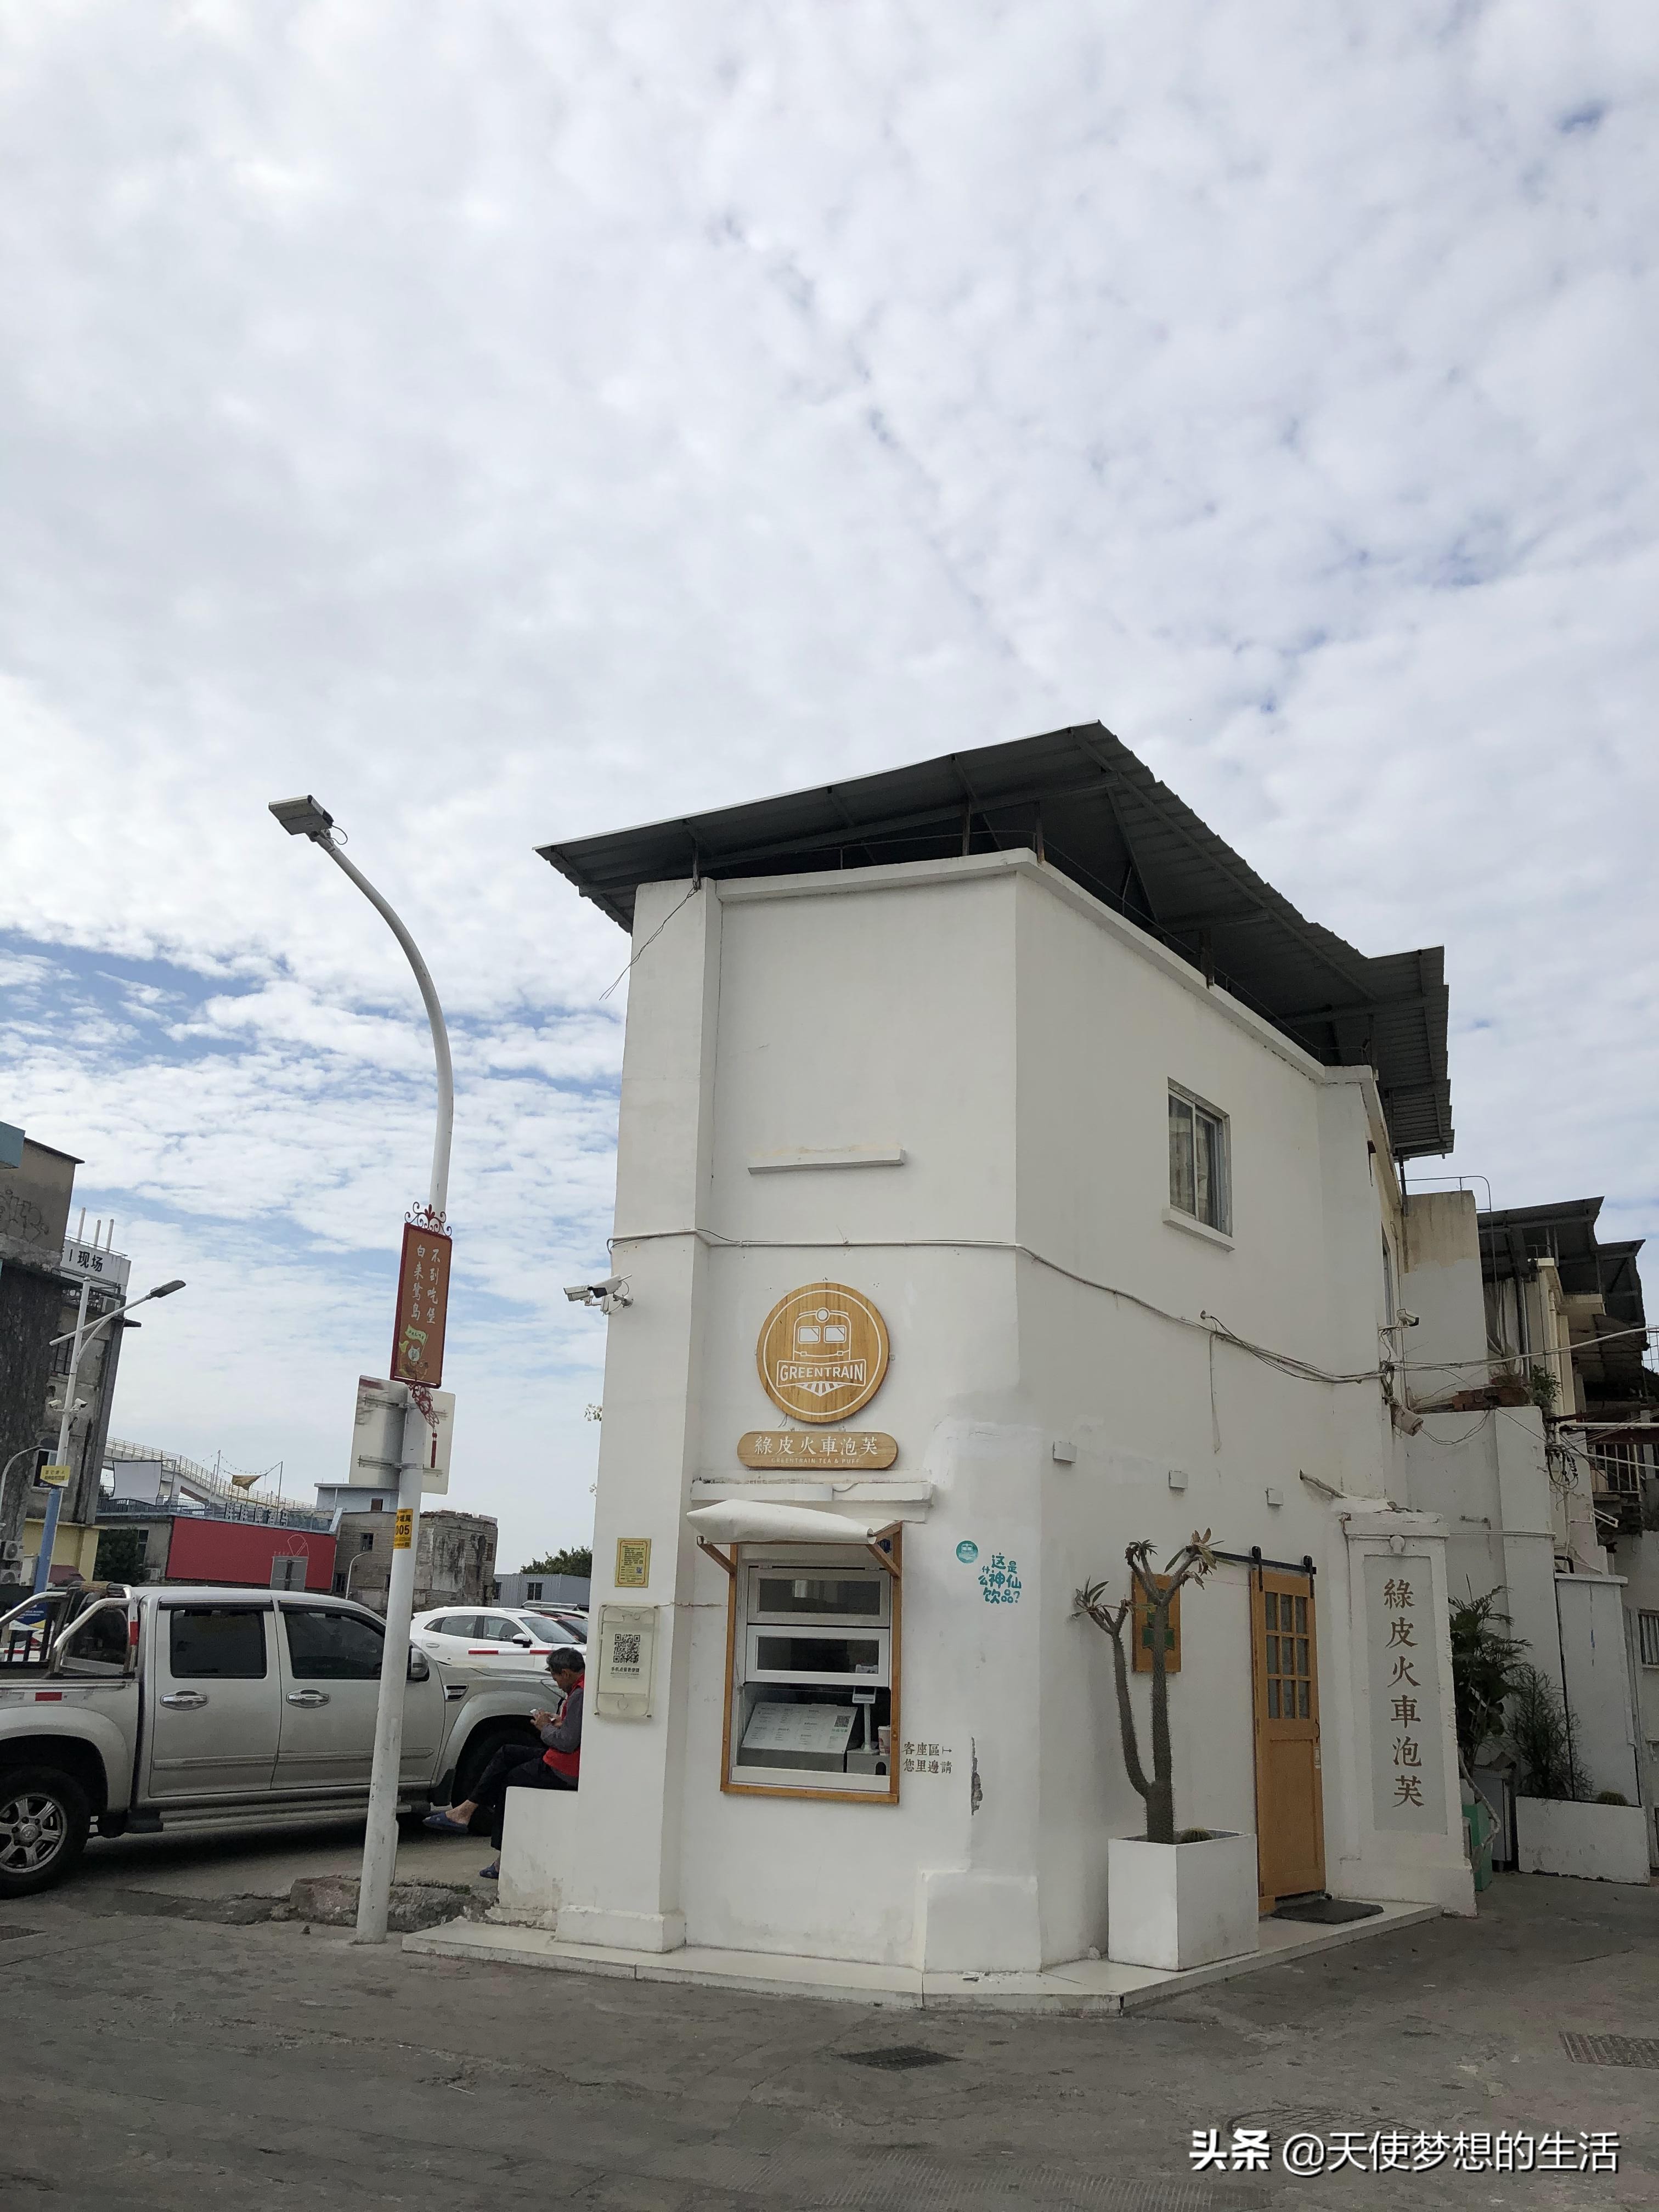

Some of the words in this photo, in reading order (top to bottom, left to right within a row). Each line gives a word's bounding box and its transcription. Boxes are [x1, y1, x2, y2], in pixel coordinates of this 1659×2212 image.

[77, 1250, 103, 1272] 现场
[427, 1249, 441, 1324] 不到吃堡
[780, 1363, 864, 1381] GREENTRAIN
[754, 1436, 878, 1457] 綠皮火車泡芙
[991, 1552, 1017, 1574] 这是
[978, 1565, 1022, 1589] 什么神仙
[1384, 1578, 1424, 1808] 綠皮火車泡芙
[901, 1741, 939, 1756] 客座區
